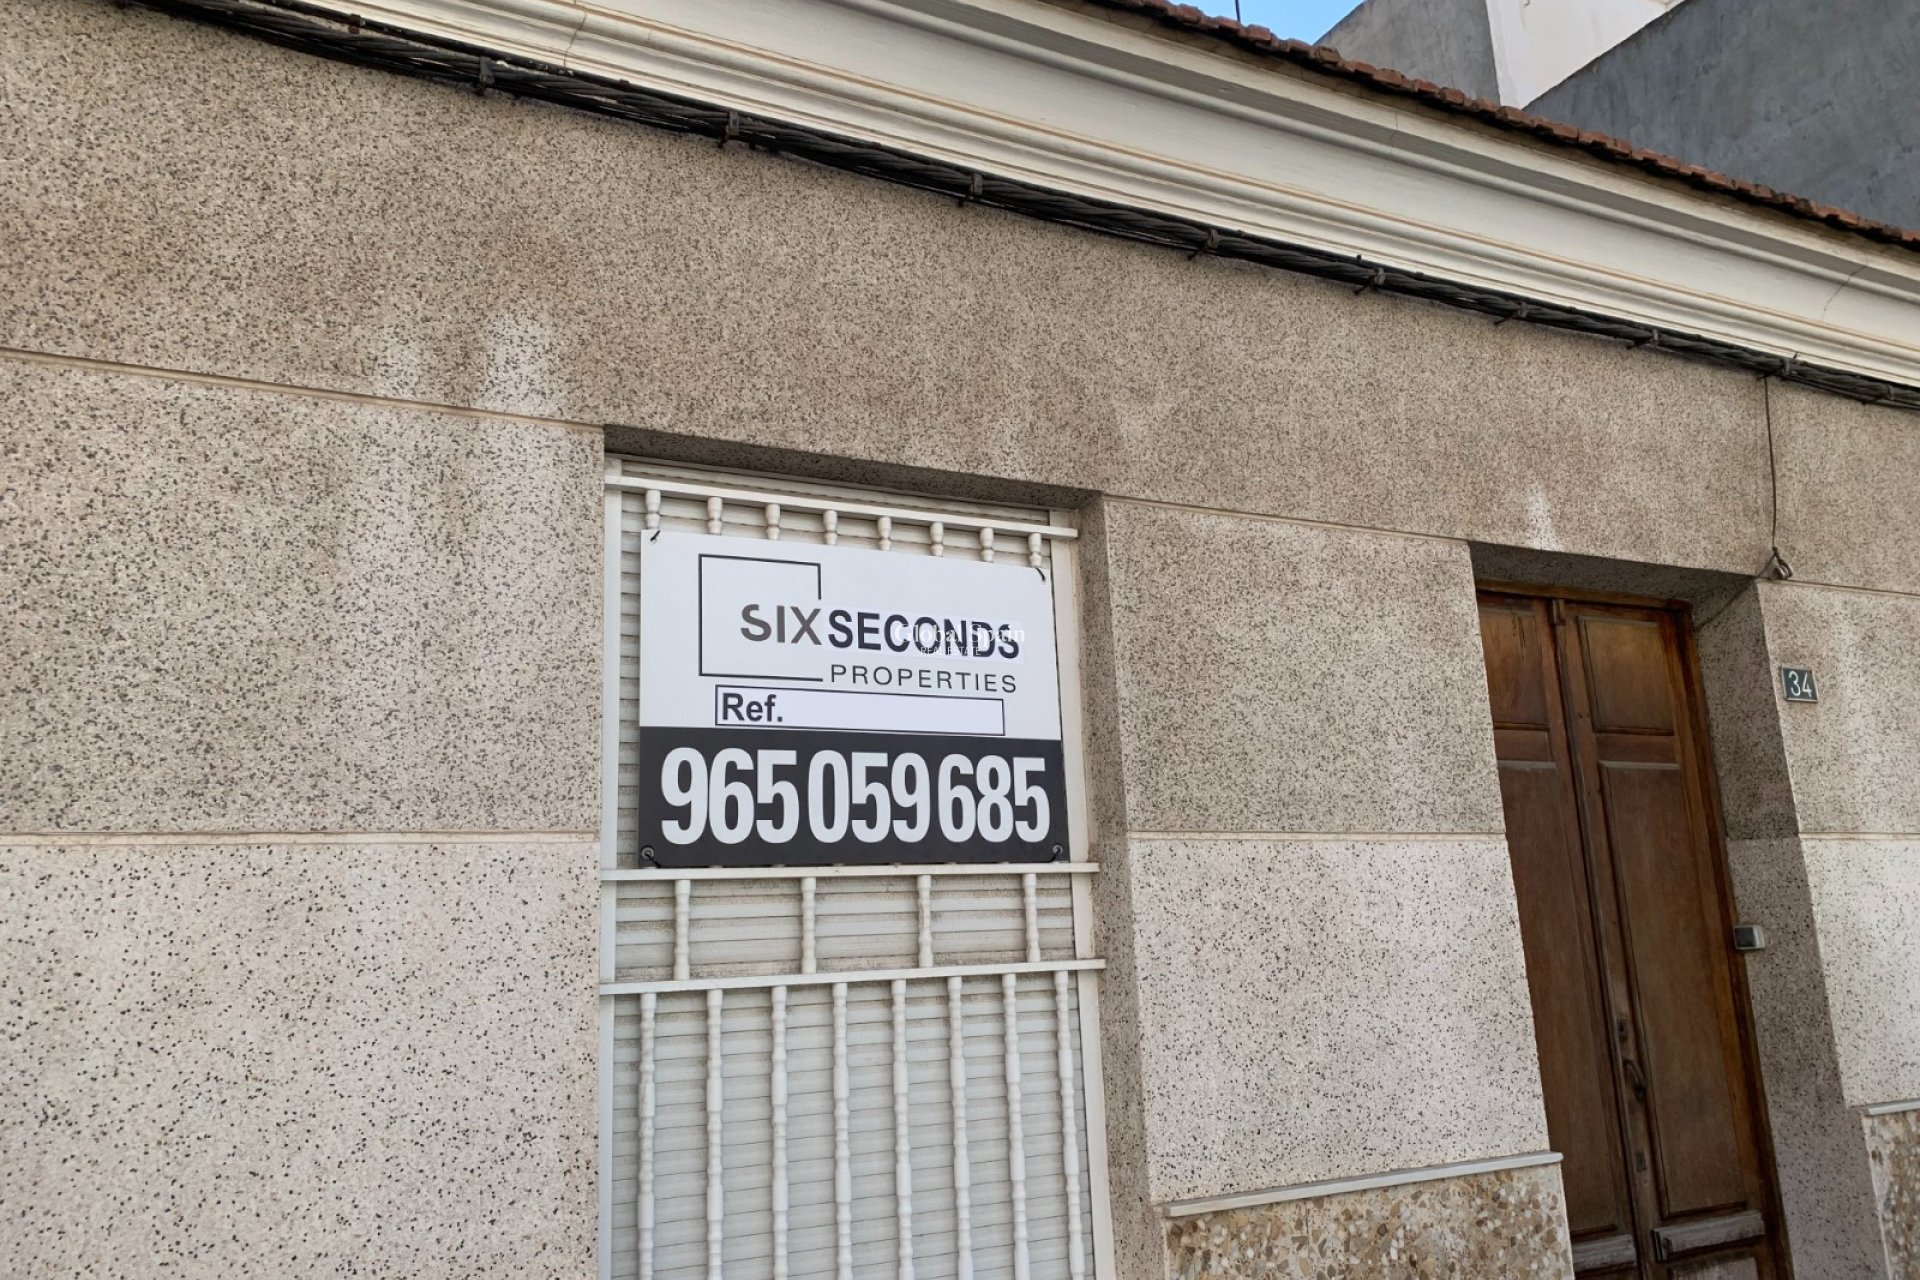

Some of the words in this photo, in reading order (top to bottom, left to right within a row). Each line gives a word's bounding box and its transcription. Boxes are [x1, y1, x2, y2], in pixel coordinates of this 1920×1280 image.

[830, 664, 1017, 693] PROPERTIES
[1788, 670, 1812, 697] 34
[722, 692, 783, 722] Ref.
